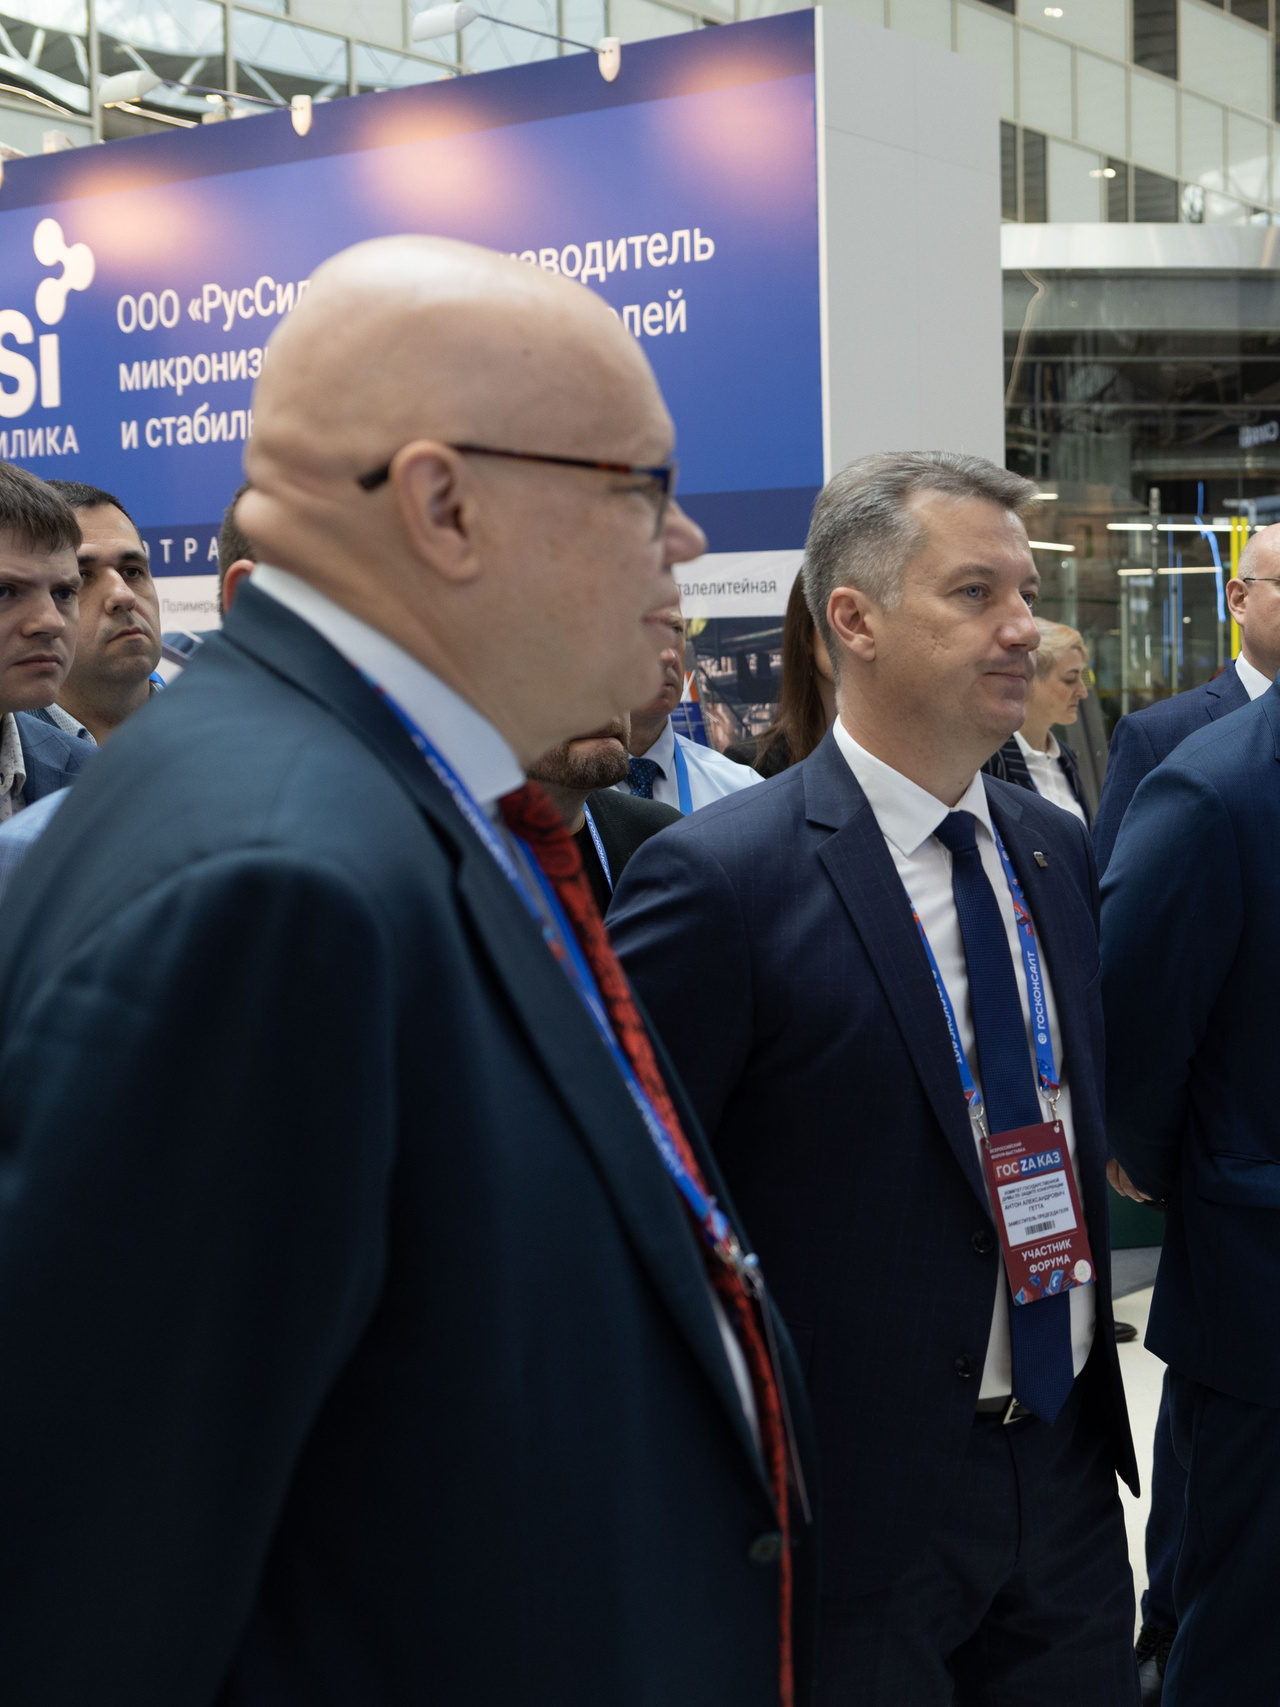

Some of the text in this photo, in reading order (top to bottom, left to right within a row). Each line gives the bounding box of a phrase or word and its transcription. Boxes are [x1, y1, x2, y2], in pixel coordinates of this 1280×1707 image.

[117, 289, 180, 333] ООО
[118, 288, 687, 396] микрониз лей
[121, 420, 139, 450] и
[1027, 951, 1045, 1029] ГОСКОНСАЛТ
[1004, 1190, 1065, 1210] АНТОН АЛЕКСАНДРОВИЧ
[1028, 1203, 1044, 1211] ГЕТТА
[1021, 1238, 1072, 1261] УЧАСТНИК
[1029, 1253, 1071, 1274] ФОРУМА
